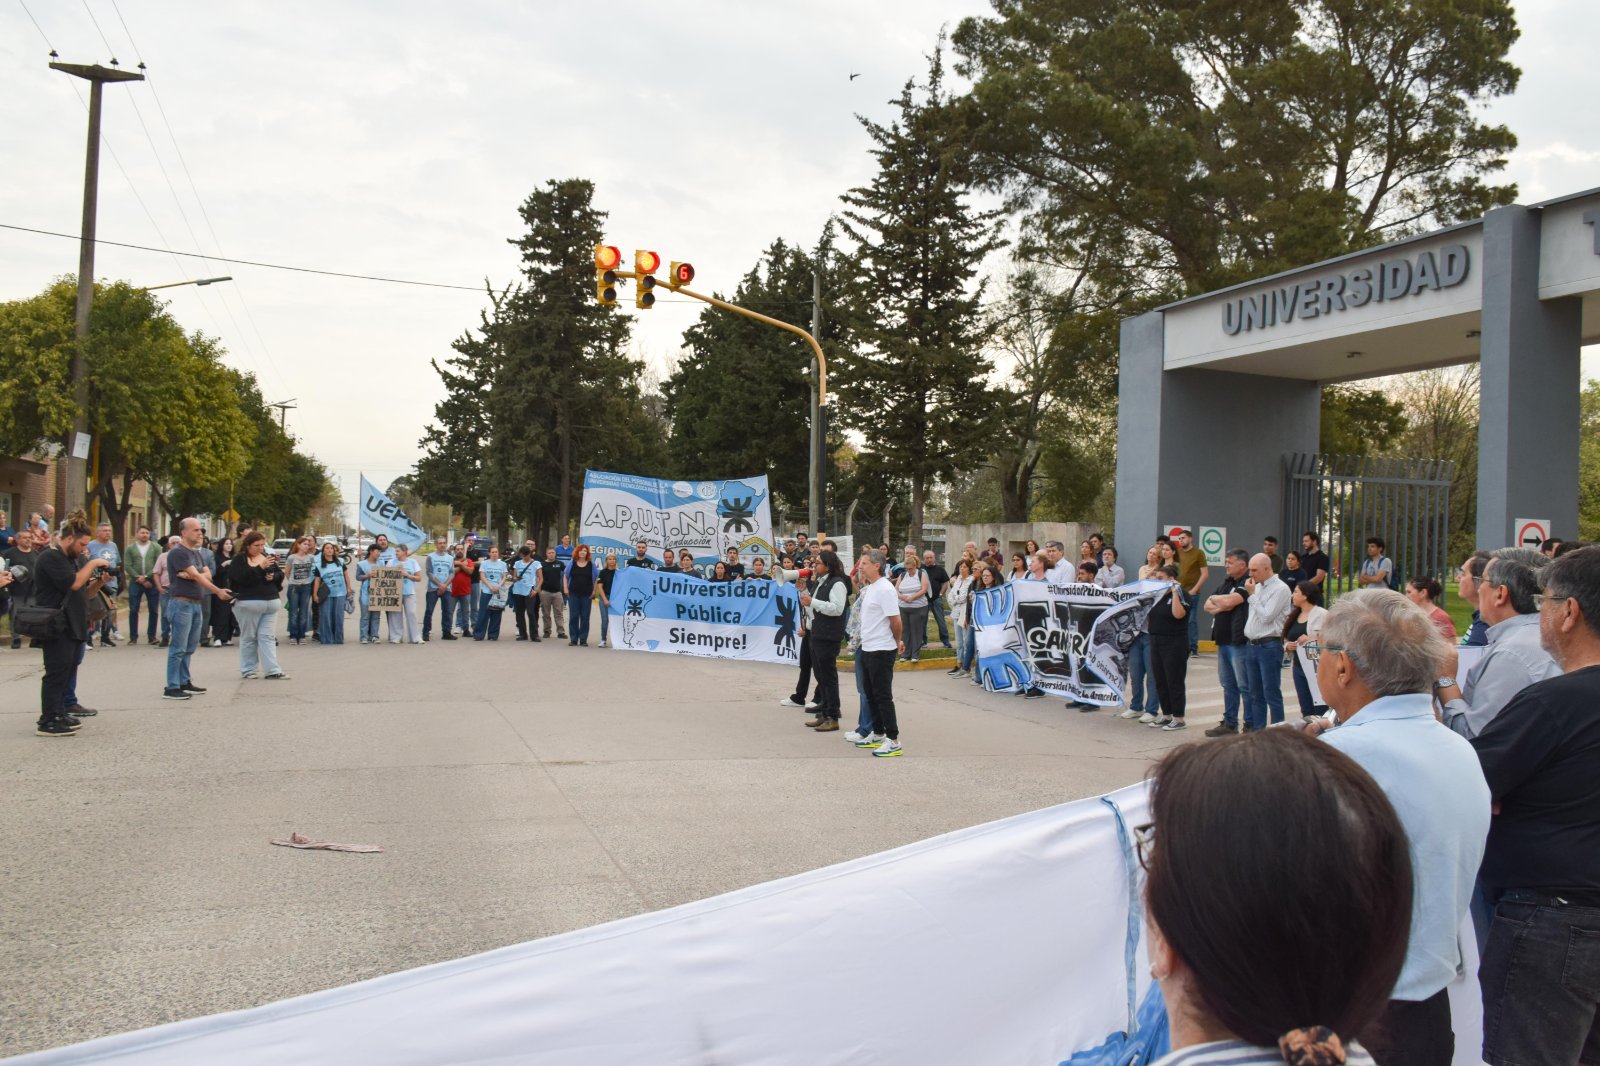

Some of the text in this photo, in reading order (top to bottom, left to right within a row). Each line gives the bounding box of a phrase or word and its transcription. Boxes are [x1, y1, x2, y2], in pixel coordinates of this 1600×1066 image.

[680, 266, 688, 279] 6
[1221, 244, 1470, 336] UNIVERSIDAD
[584, 502, 716, 537] A.P.U.T.N.
[589, 546, 634, 557] EGIONAL
[652, 577, 770, 599] ¡Universidad
[676, 603, 742, 624] Pública
[669, 627, 746, 651] Siempre!
[776, 646, 798, 660] UTN
